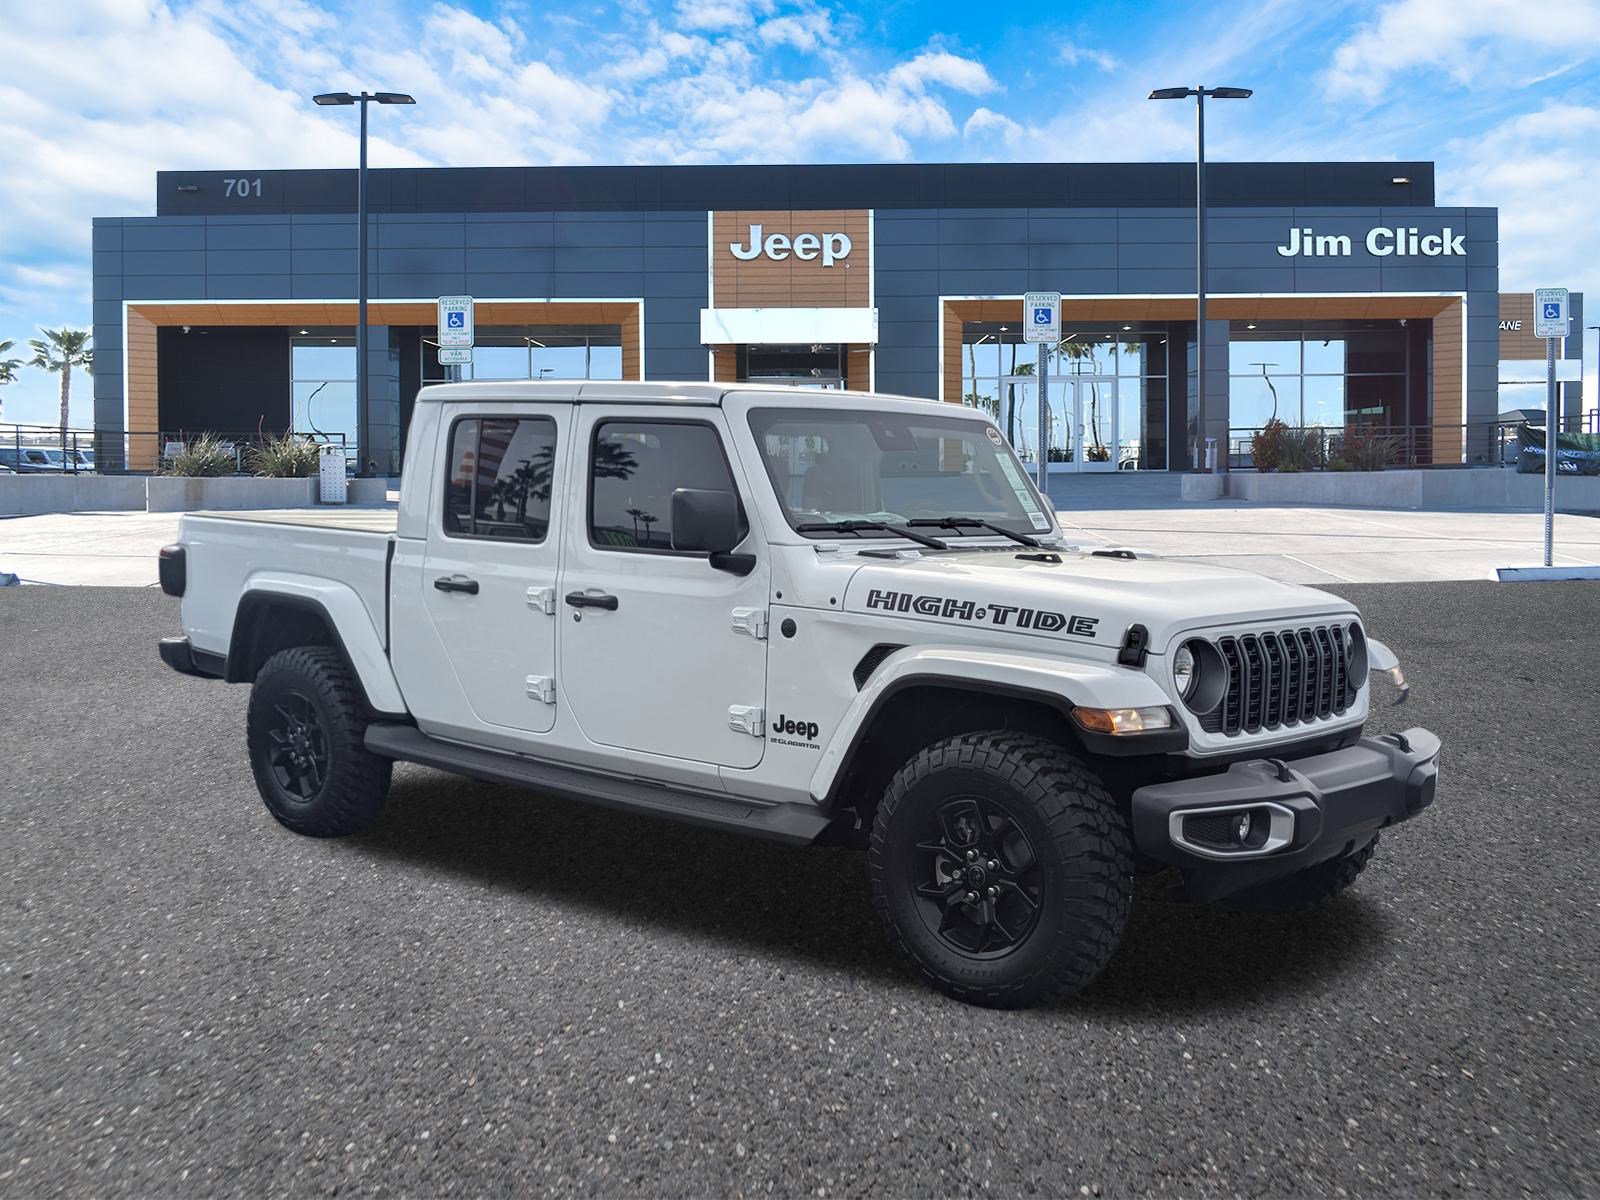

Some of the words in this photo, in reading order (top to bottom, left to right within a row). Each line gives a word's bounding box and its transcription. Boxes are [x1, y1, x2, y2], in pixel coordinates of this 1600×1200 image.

[223, 178, 261, 197] 701
[730, 224, 852, 268] Jeep
[1277, 228, 1351, 257] Jim
[1366, 227, 1467, 256] Click
[1498, 320, 1522, 331] ANE
[866, 589, 977, 621] HIGH
[987, 603, 1099, 638] TIDE
[773, 714, 819, 741] Jeep
[778, 738, 820, 750] GLADIATOR
